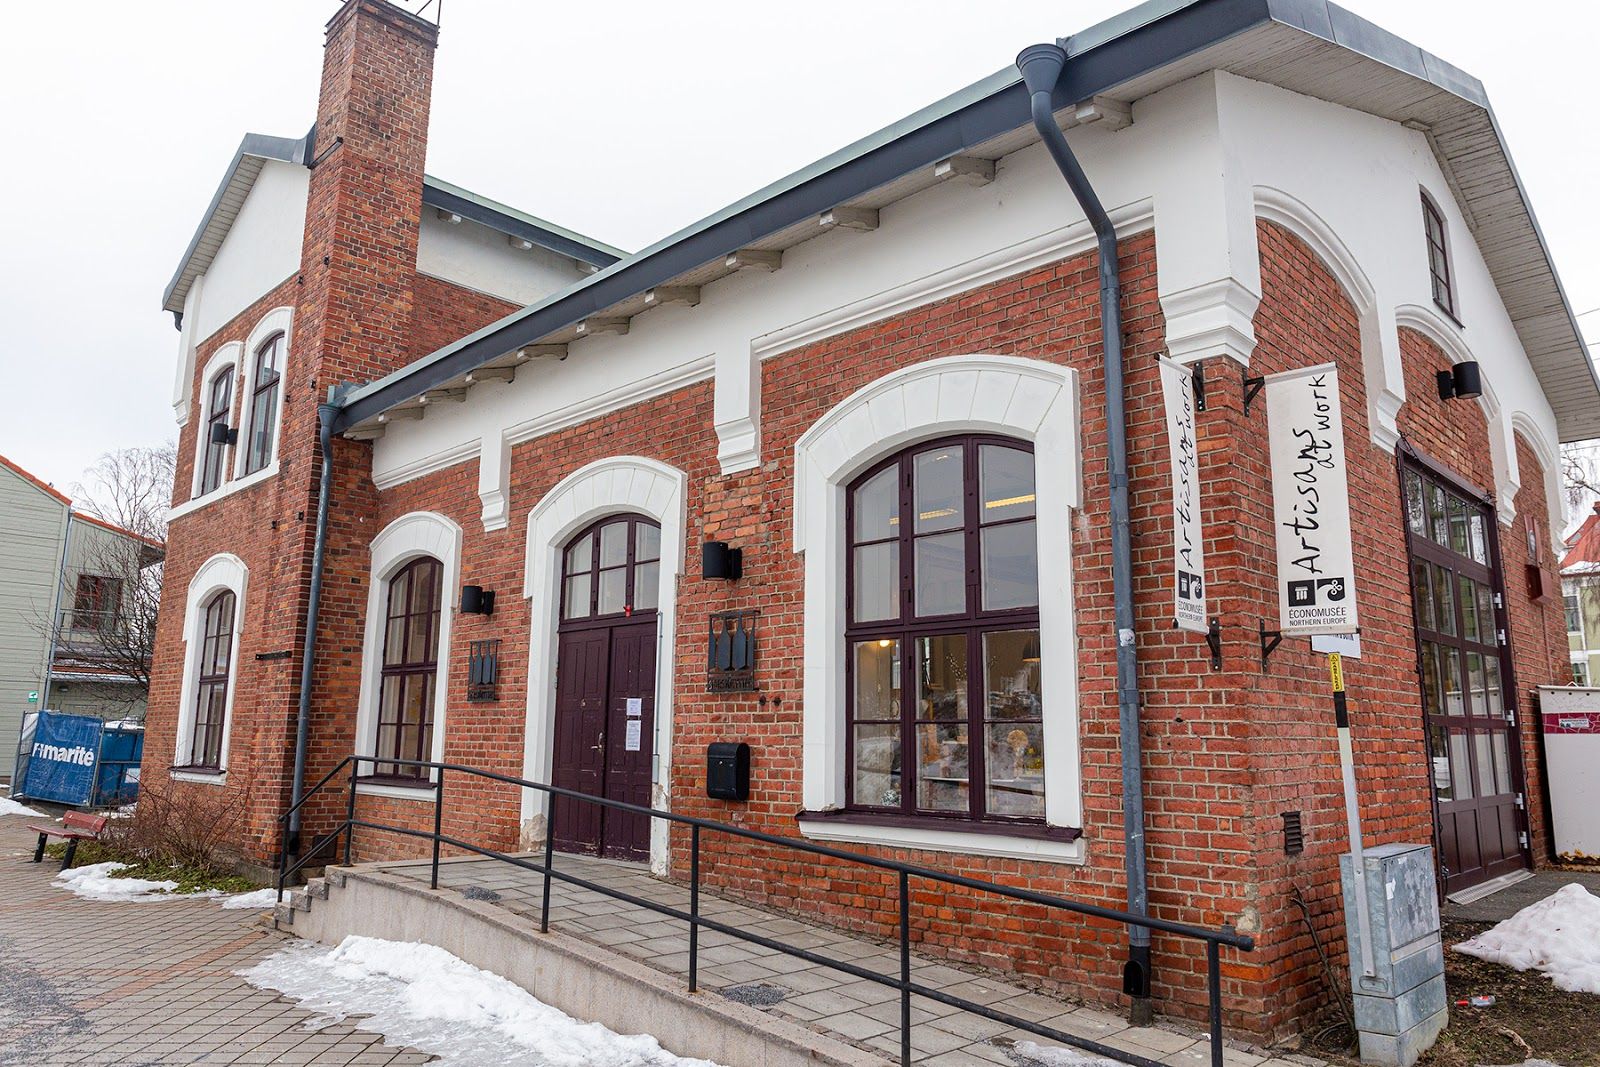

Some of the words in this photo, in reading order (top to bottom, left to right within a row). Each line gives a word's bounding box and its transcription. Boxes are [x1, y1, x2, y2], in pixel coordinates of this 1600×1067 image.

[1179, 374, 1192, 430] work
[1308, 373, 1331, 430] work
[1308, 440, 1335, 469] at
[1175, 415, 1193, 569] Artisans
[1282, 427, 1322, 575] Artisans
[1288, 606, 1347, 619] ÉCONOMUSÉE
[1289, 618, 1322, 627] NORTHERN
[1322, 617, 1347, 625] EUROPE
